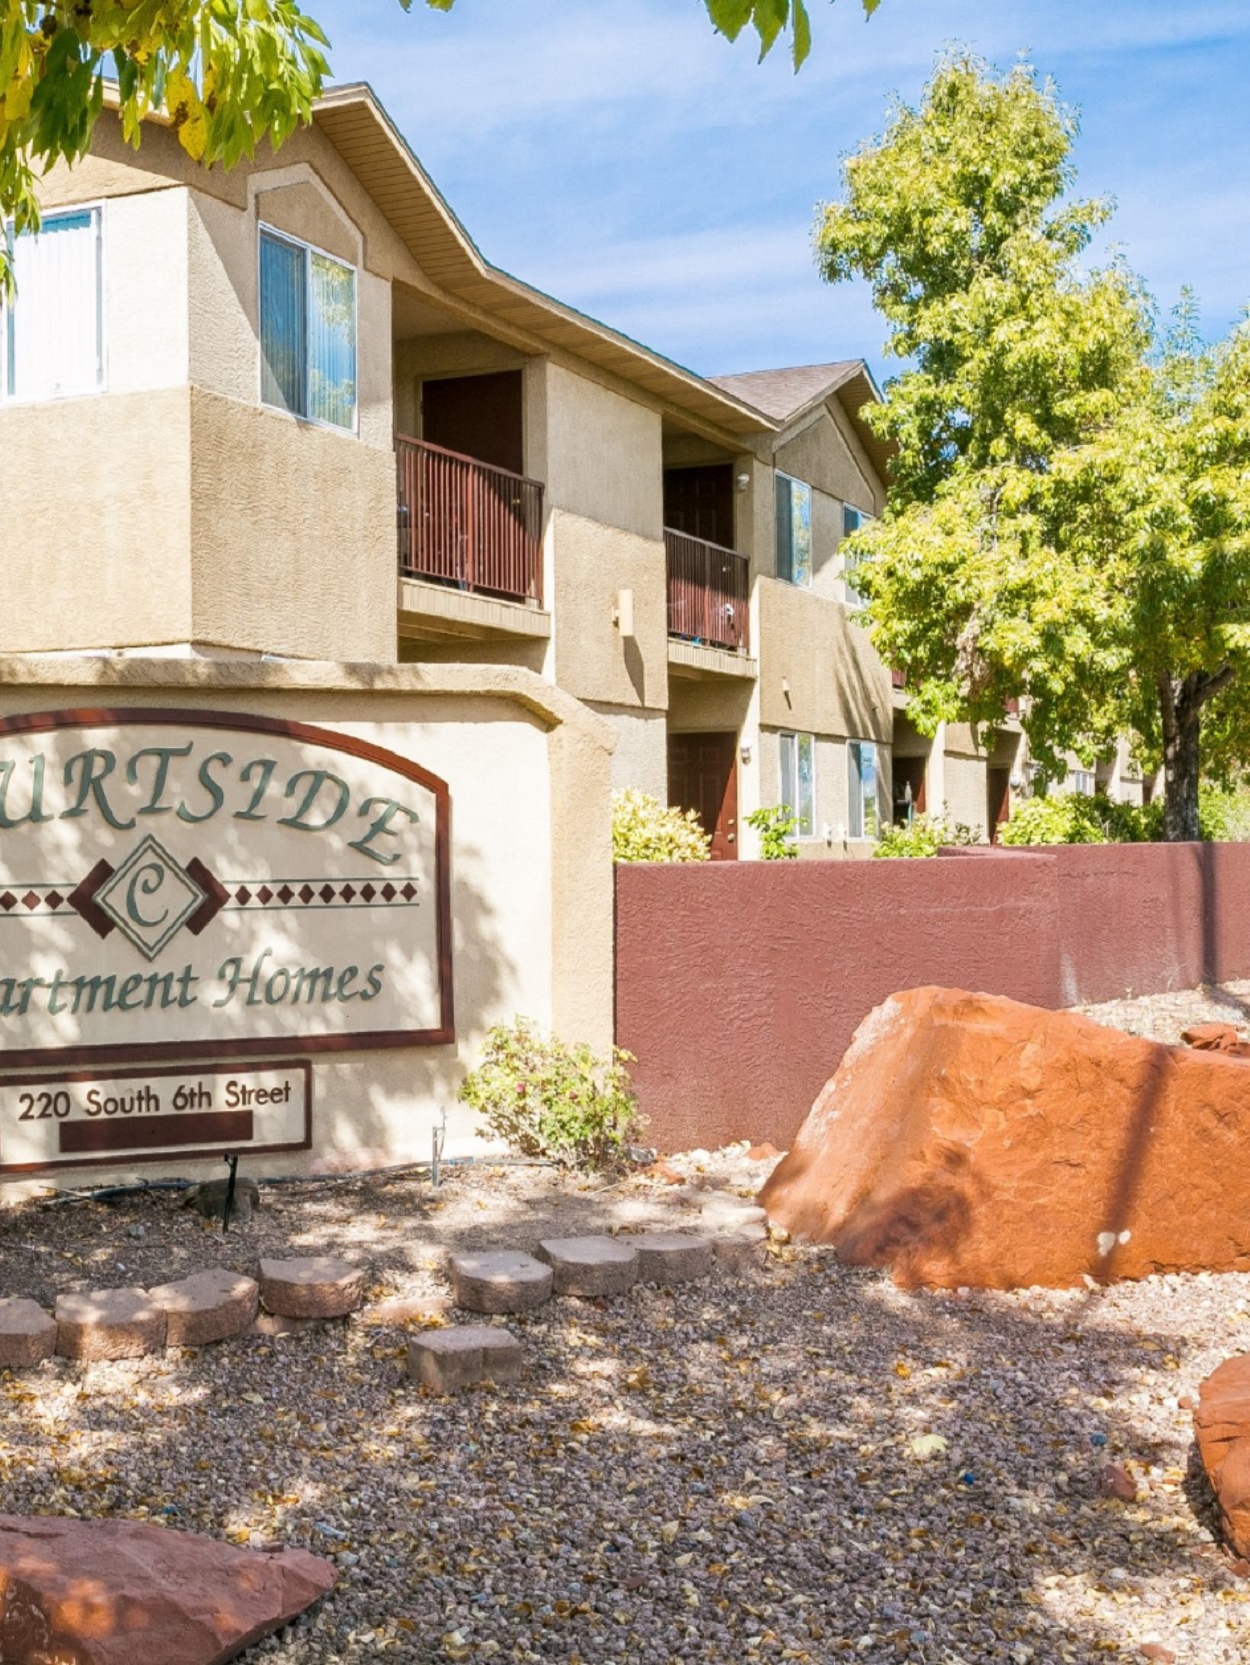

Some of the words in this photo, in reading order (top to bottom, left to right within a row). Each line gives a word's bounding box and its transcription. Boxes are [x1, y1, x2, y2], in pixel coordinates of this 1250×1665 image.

[125, 861, 170, 928] C
[213, 948, 384, 1008] Homes
[18, 1090, 71, 1121] 220
[86, 1085, 160, 1117] South
[172, 1081, 212, 1110] 6th
[225, 1079, 291, 1107] Street
